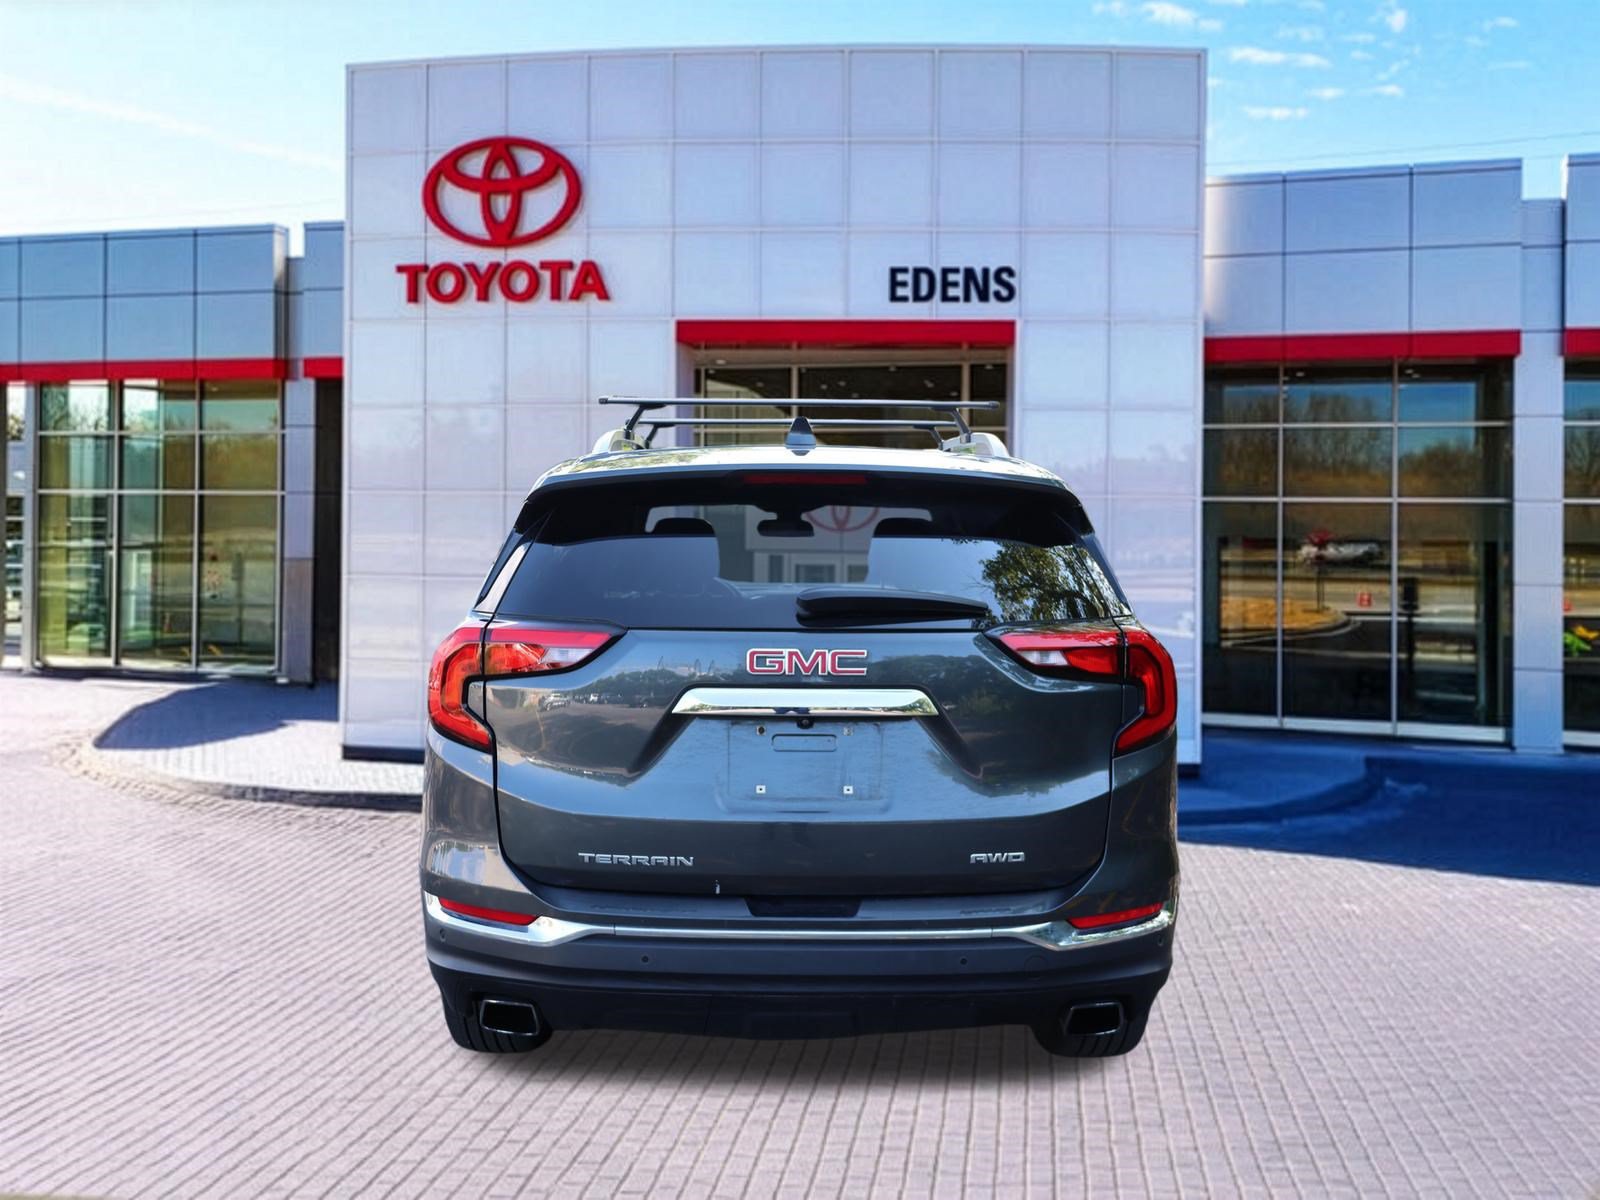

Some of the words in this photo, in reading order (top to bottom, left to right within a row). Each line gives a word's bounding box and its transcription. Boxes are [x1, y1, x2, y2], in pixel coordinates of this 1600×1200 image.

[396, 260, 610, 304] TOYOTA
[889, 266, 1017, 304] EDENS
[746, 648, 868, 676] GMC
[578, 852, 695, 868] TERRAIN
[969, 851, 1026, 865] AWD
